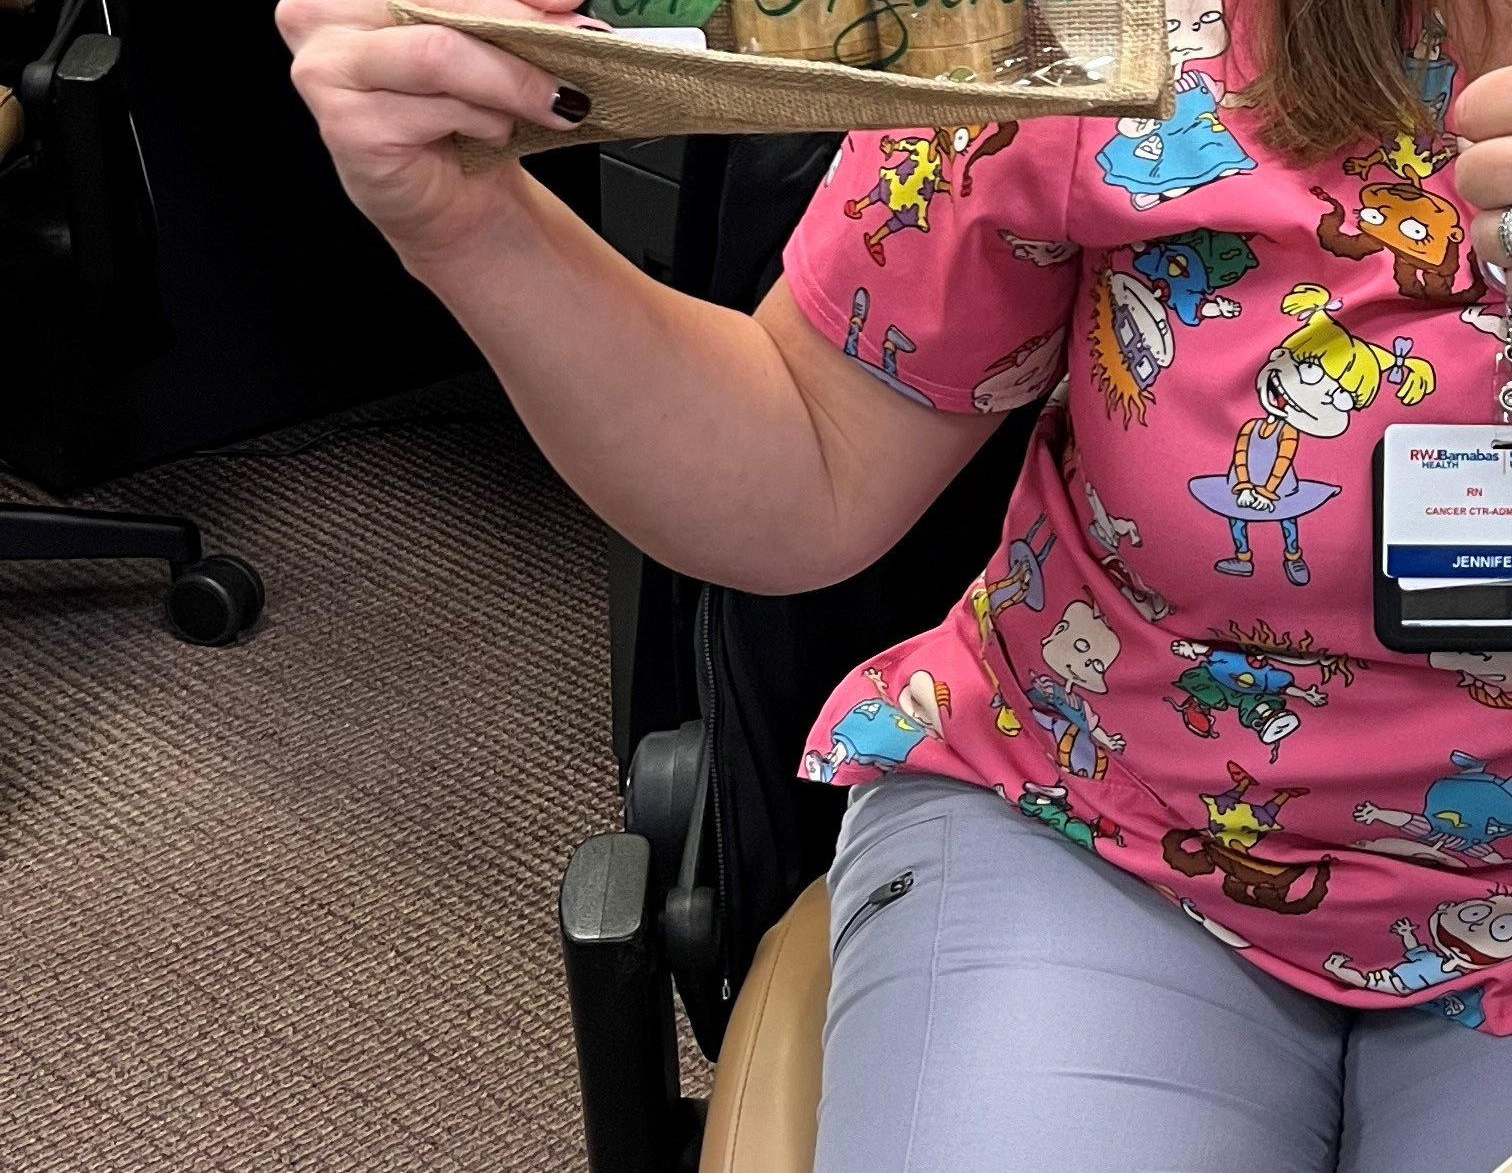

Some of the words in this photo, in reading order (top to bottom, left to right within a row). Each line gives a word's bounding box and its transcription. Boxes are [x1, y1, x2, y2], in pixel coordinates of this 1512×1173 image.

[1410, 449, 1499, 462] RWJBarnabas
[1422, 461, 1459, 469] HEALTH
[1466, 487, 1483, 497] RN
[1425, 507, 1467, 516] CANCER
